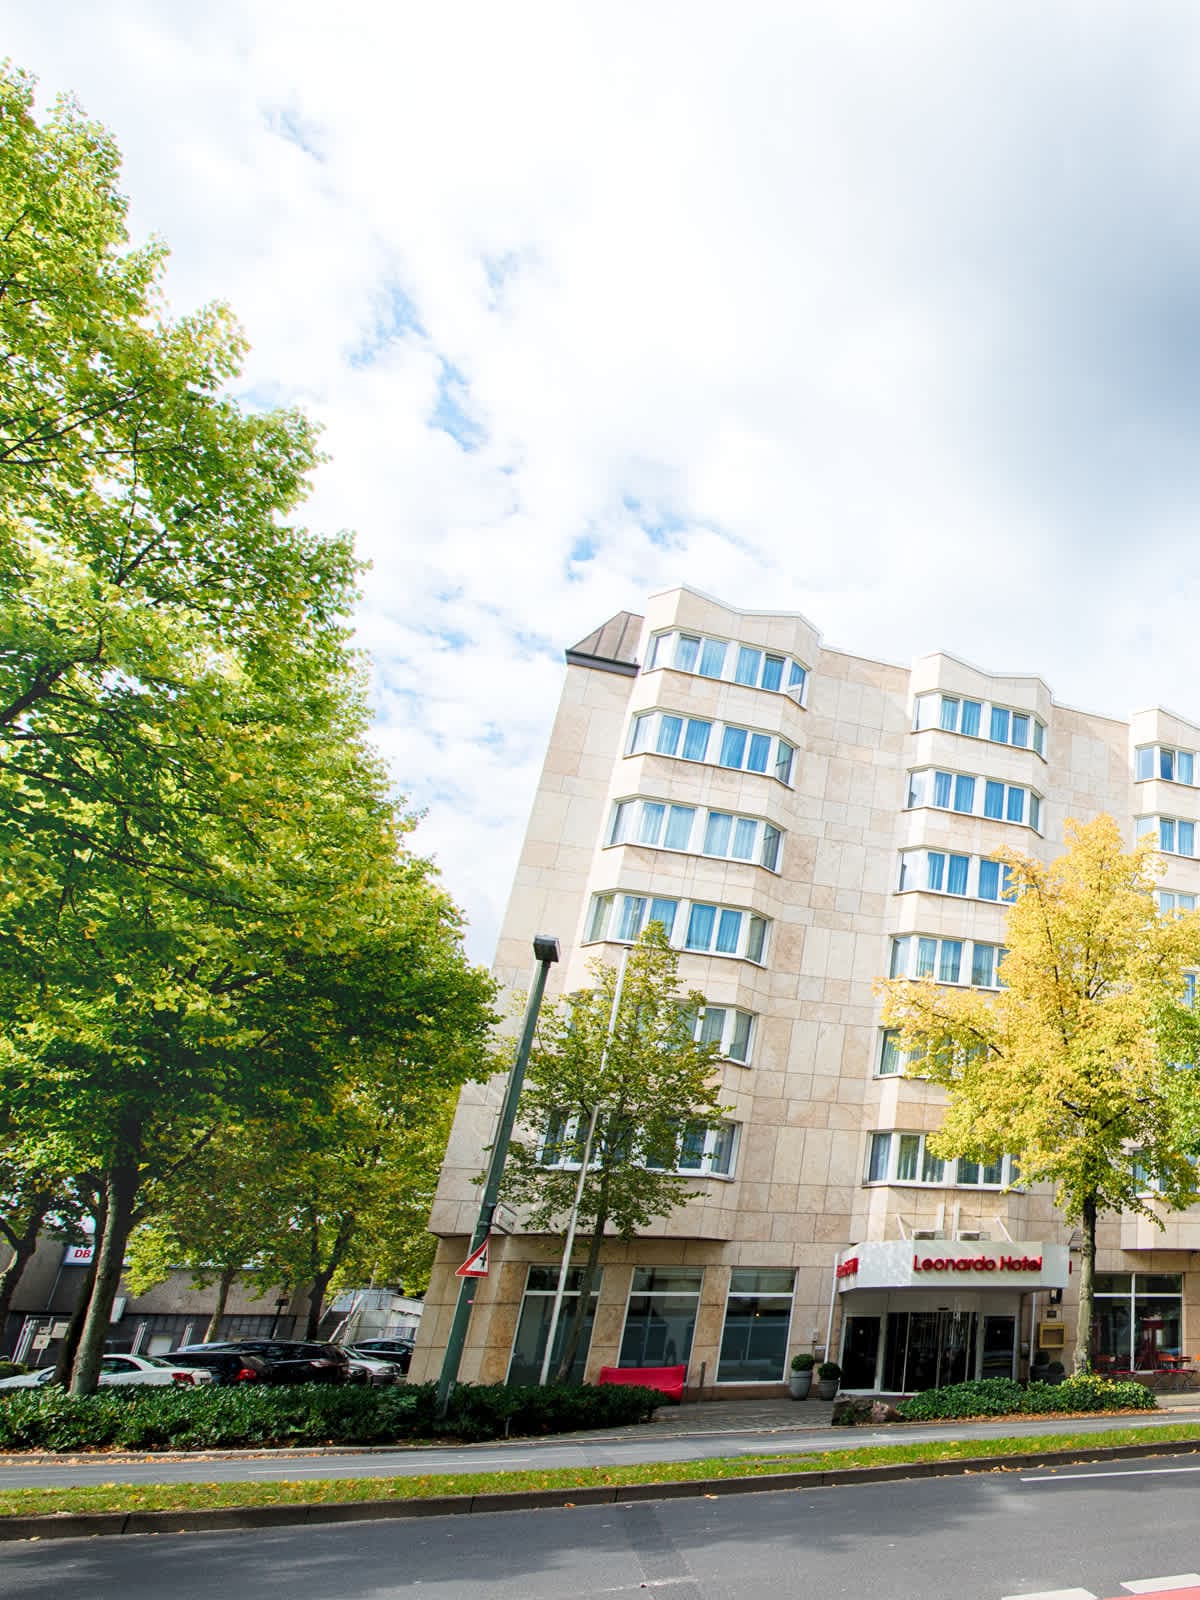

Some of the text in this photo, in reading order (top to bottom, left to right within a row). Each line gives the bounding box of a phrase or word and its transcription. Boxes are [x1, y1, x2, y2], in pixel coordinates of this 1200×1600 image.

[74, 1249, 91, 1258] DB
[913, 1254, 1043, 1272] Leonardo Hotel
